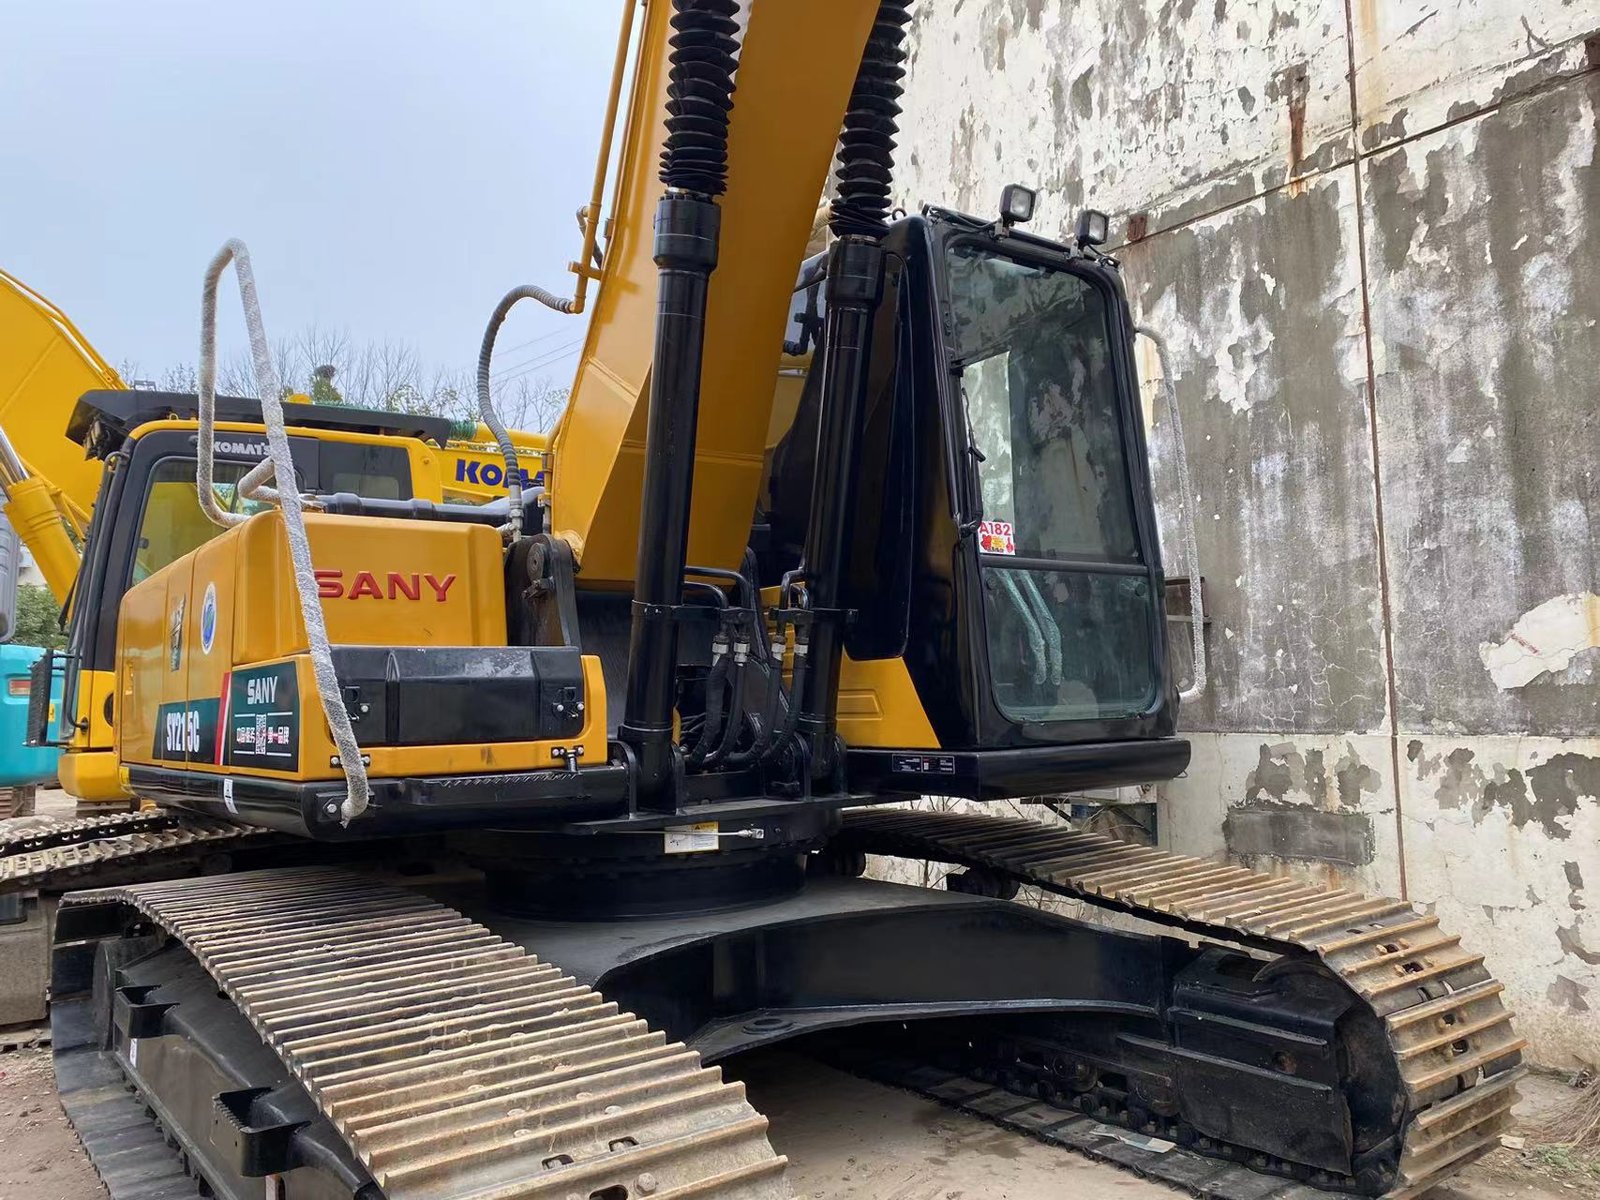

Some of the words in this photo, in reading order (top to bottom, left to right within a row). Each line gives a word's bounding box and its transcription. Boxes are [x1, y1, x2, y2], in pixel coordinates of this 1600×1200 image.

[979, 522, 1012, 536] A182
[313, 569, 457, 602] SANY
[247, 675, 278, 705] SANY
[166, 710, 200, 753] SY215C
